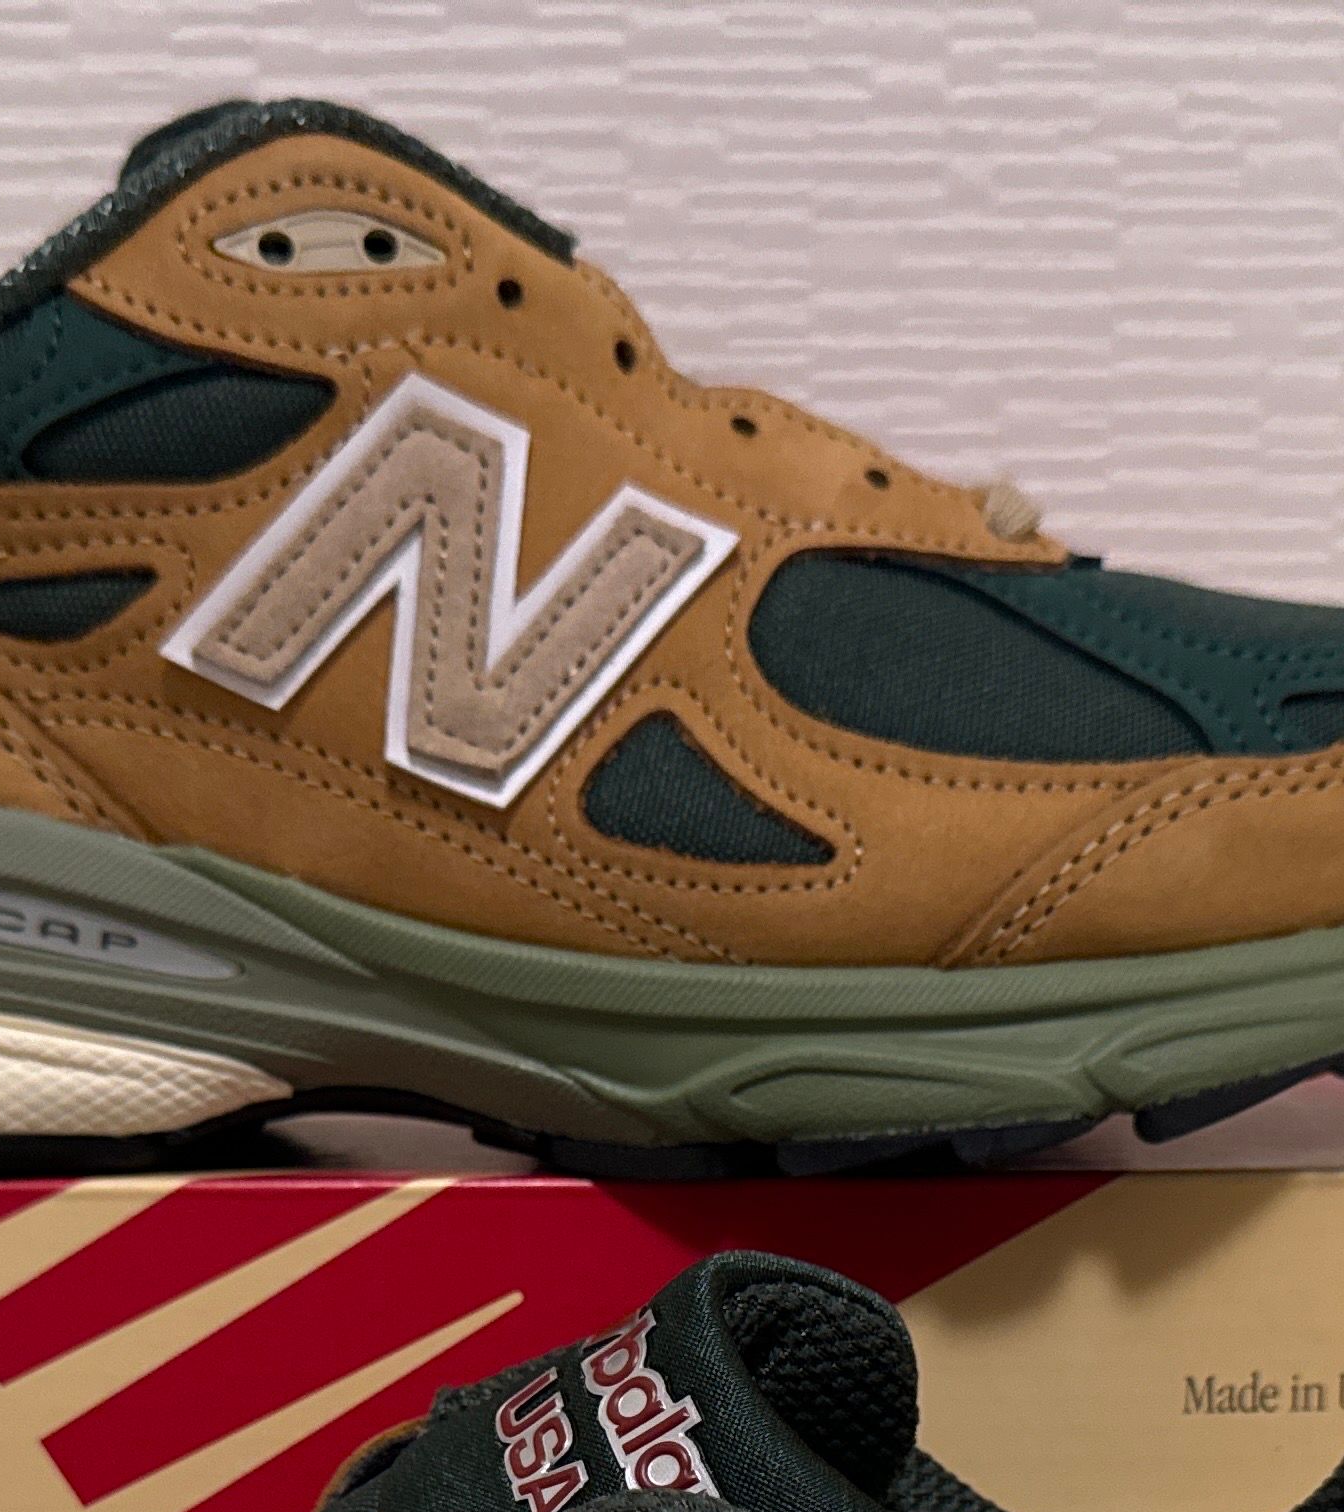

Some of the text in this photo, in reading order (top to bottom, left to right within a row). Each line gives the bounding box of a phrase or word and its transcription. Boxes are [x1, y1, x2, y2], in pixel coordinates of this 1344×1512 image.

[160, 372, 742, 810] N
[581, 1307, 721, 1498] bala
[1182, 1369, 1280, 1414] Made
[1288, 1374, 1327, 1412] in
